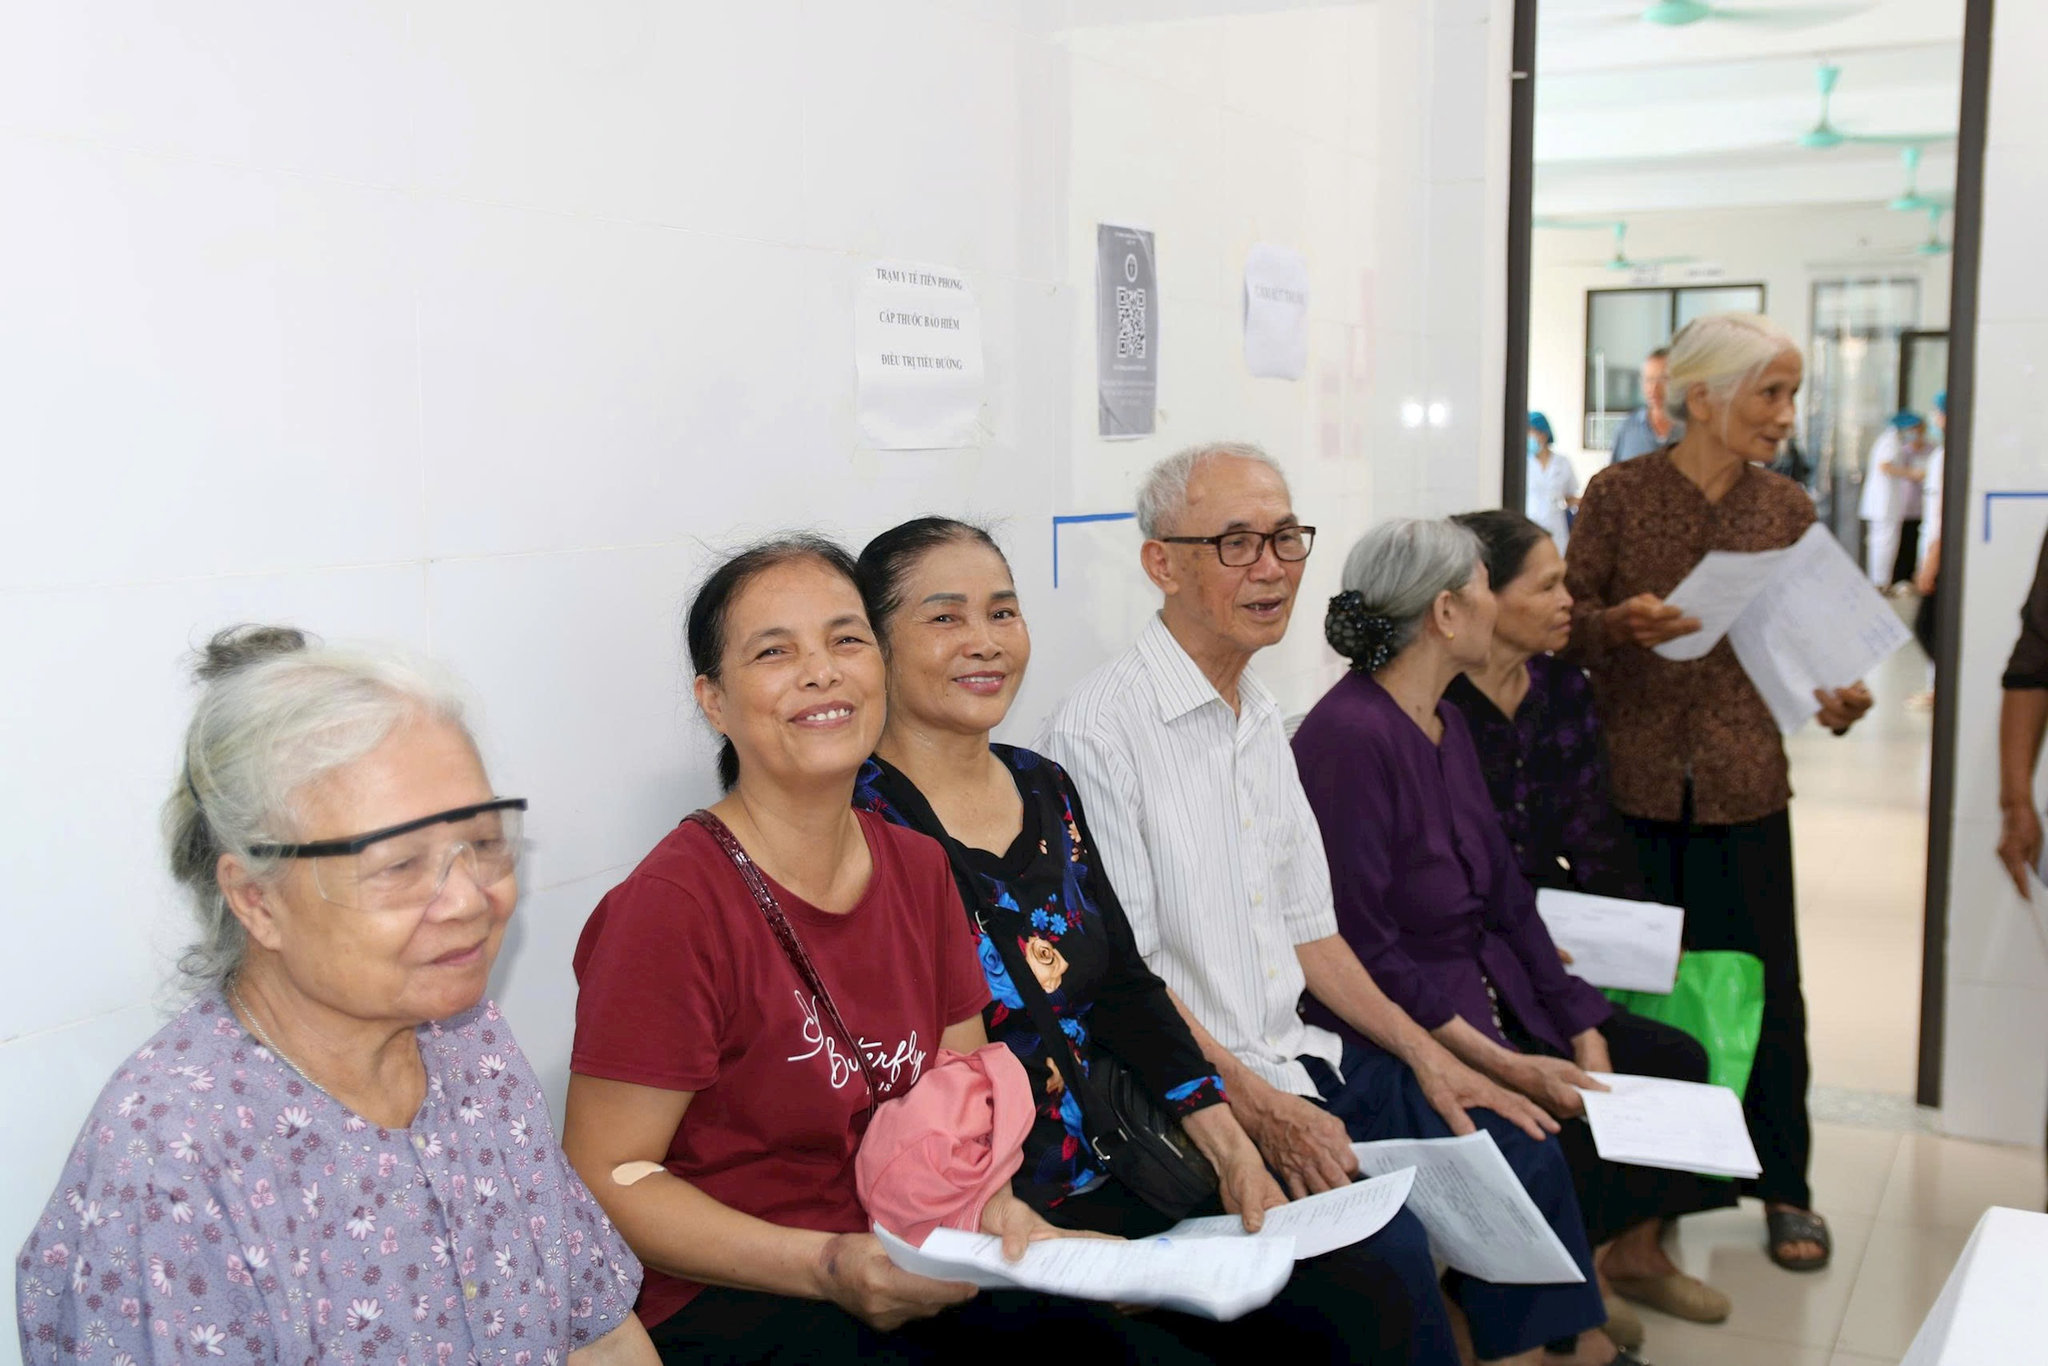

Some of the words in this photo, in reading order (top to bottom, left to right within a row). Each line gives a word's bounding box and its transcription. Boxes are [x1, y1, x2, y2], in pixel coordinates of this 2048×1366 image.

[876, 268, 899, 284] TRẠM
[901, 271, 906, 283] Y
[908, 269, 918, 285] TẾ
[938, 276, 963, 290] PHONG
[902, 354, 916, 370] TRỊ
